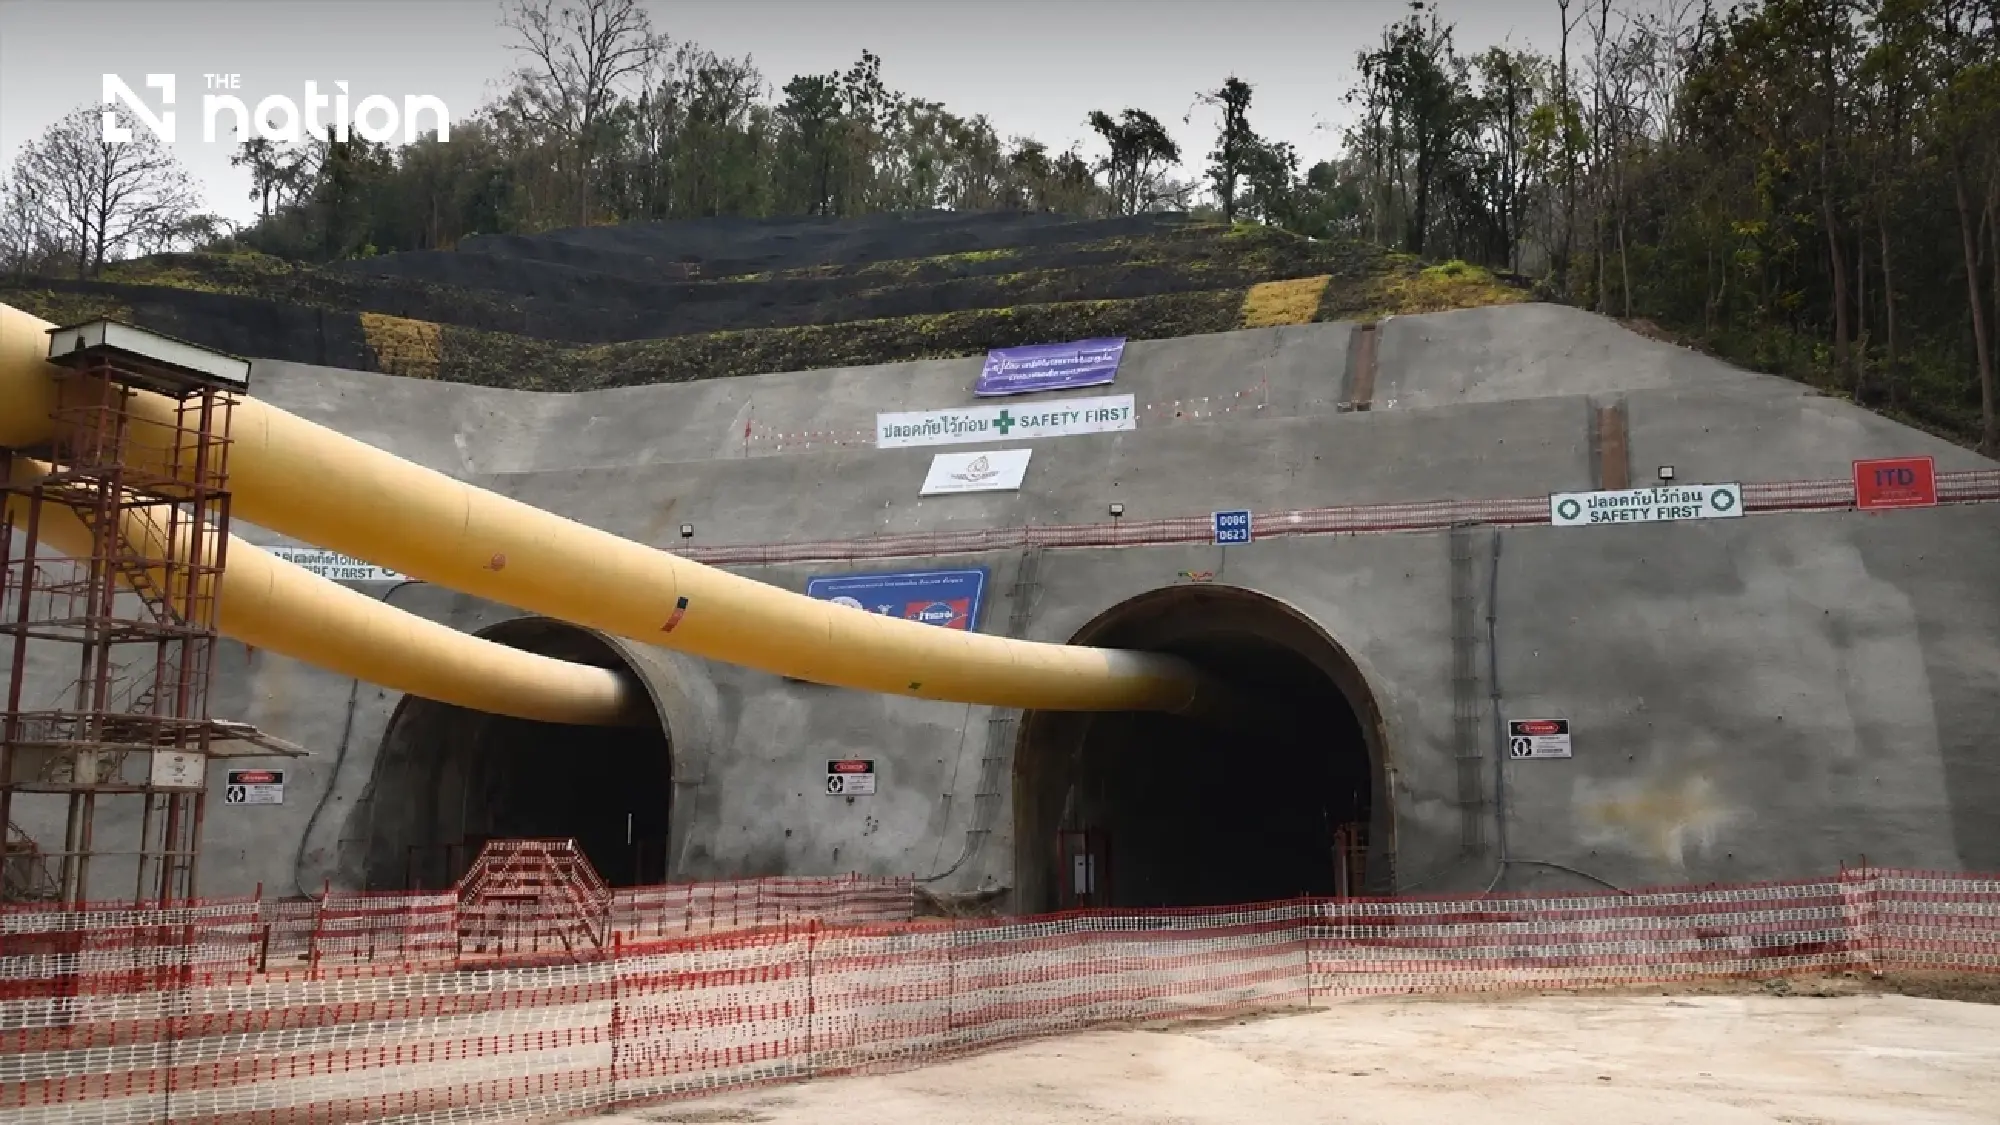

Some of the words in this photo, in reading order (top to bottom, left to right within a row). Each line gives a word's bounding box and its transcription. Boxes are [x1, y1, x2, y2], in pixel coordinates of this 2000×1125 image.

[1019, 411, 1080, 428] SAFETY
[1085, 407, 1130, 423] FIRST
[1875, 468, 1915, 487] ITD
[1590, 507, 1650, 523] SAFETY
[1657, 505, 1703, 519] FIRST
